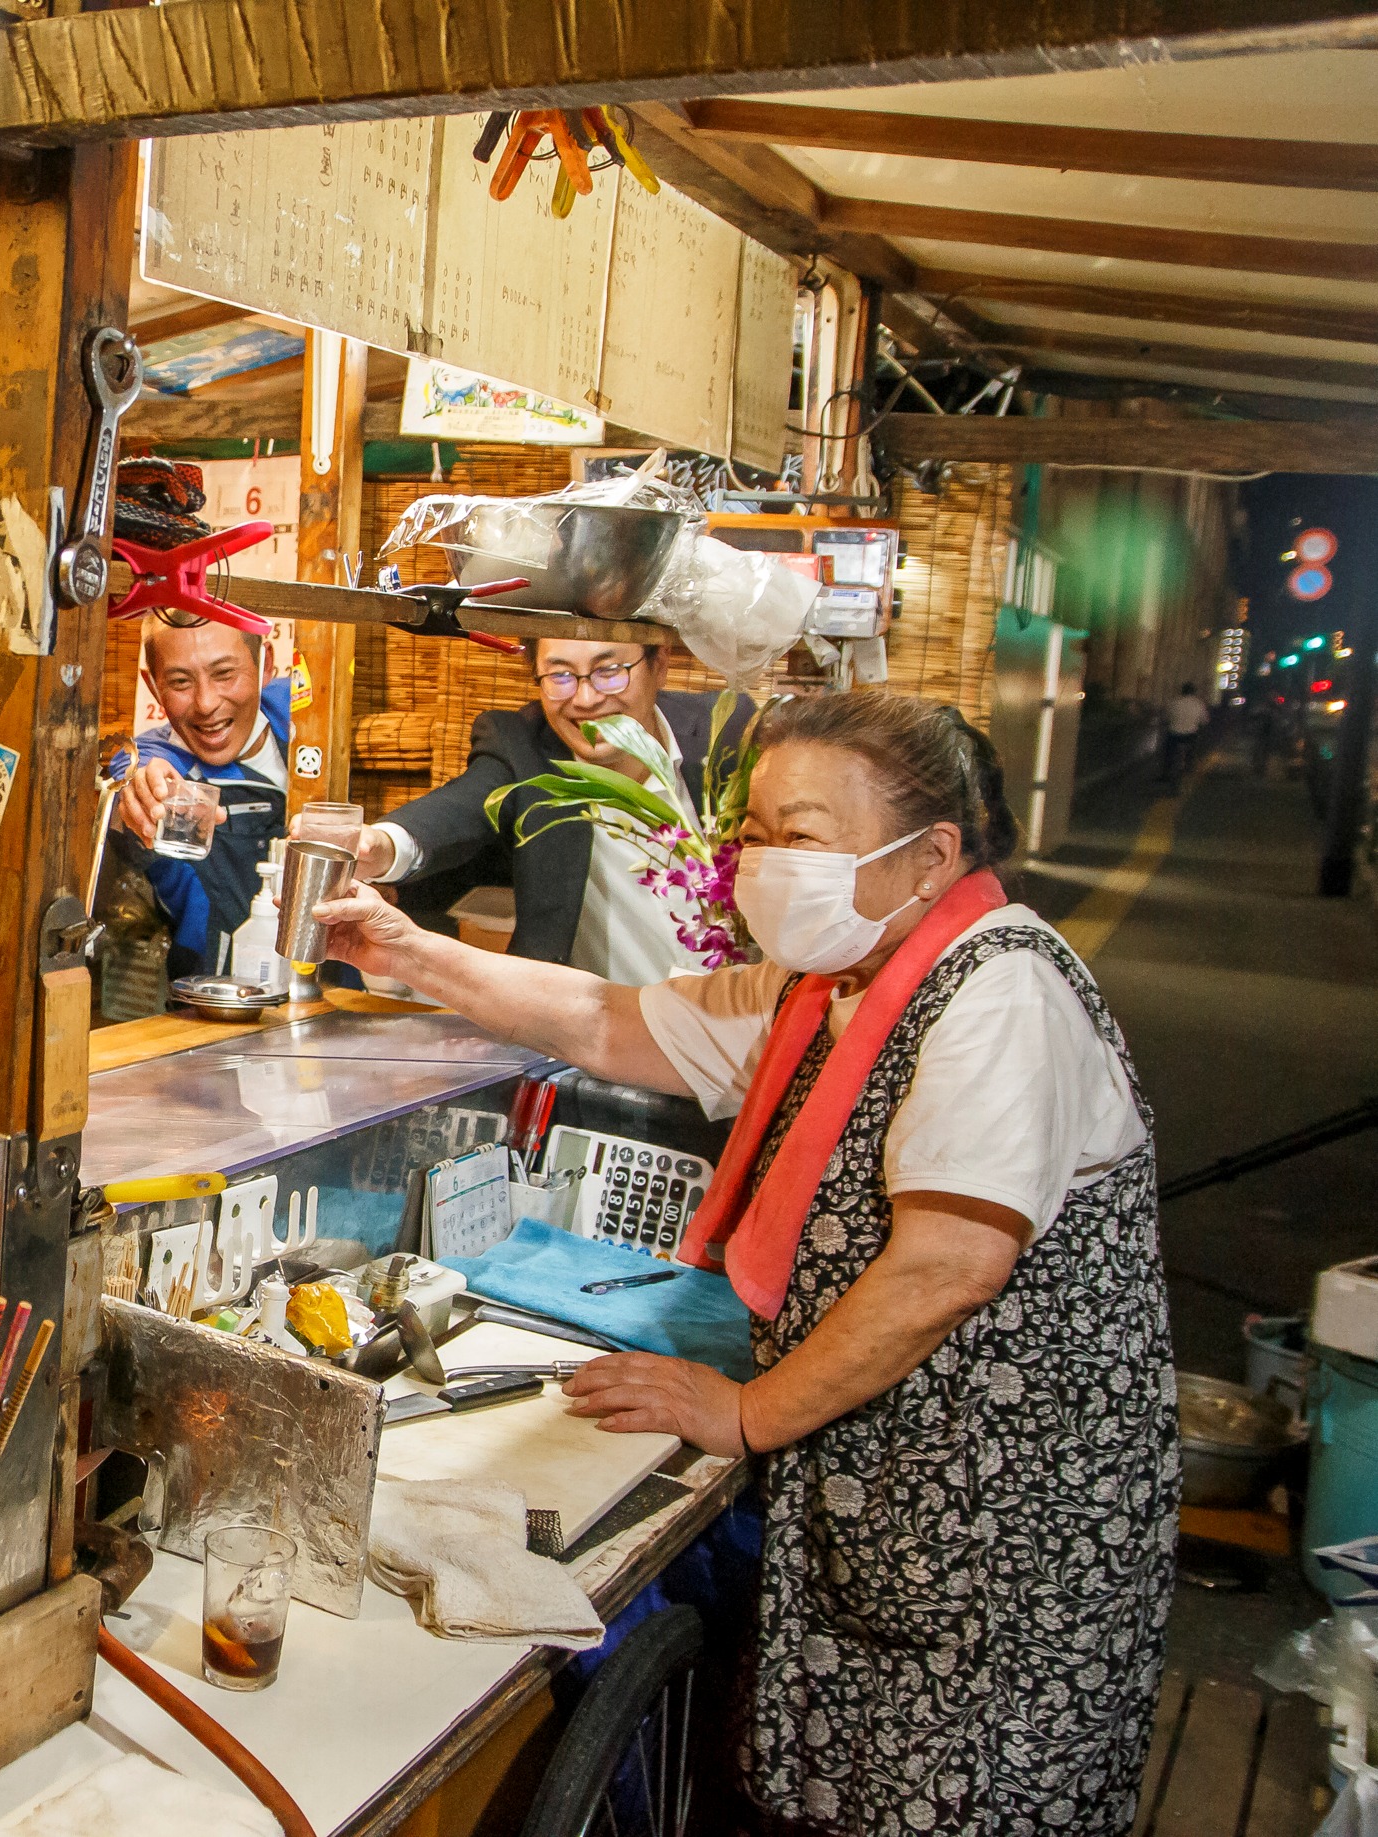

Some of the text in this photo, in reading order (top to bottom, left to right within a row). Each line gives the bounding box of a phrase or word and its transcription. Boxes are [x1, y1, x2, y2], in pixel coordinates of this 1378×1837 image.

[246, 486, 262, 515] 6
[274, 538, 278, 554] 1
[614, 1171, 628, 1182] 9
[633, 1176, 646, 1186] 6
[453, 1176, 459, 1191] 6
[651, 1180, 665, 1190] 3
[610, 1195, 623, 1205] 8
[628, 1200, 641, 1210] 5
[647, 1204, 660, 1214] 2
[665, 1205, 680, 1221] 00
[603, 1217, 617, 1228] 7
[623, 1223, 636, 1234] 4
[660, 1232, 673, 1242] 0
